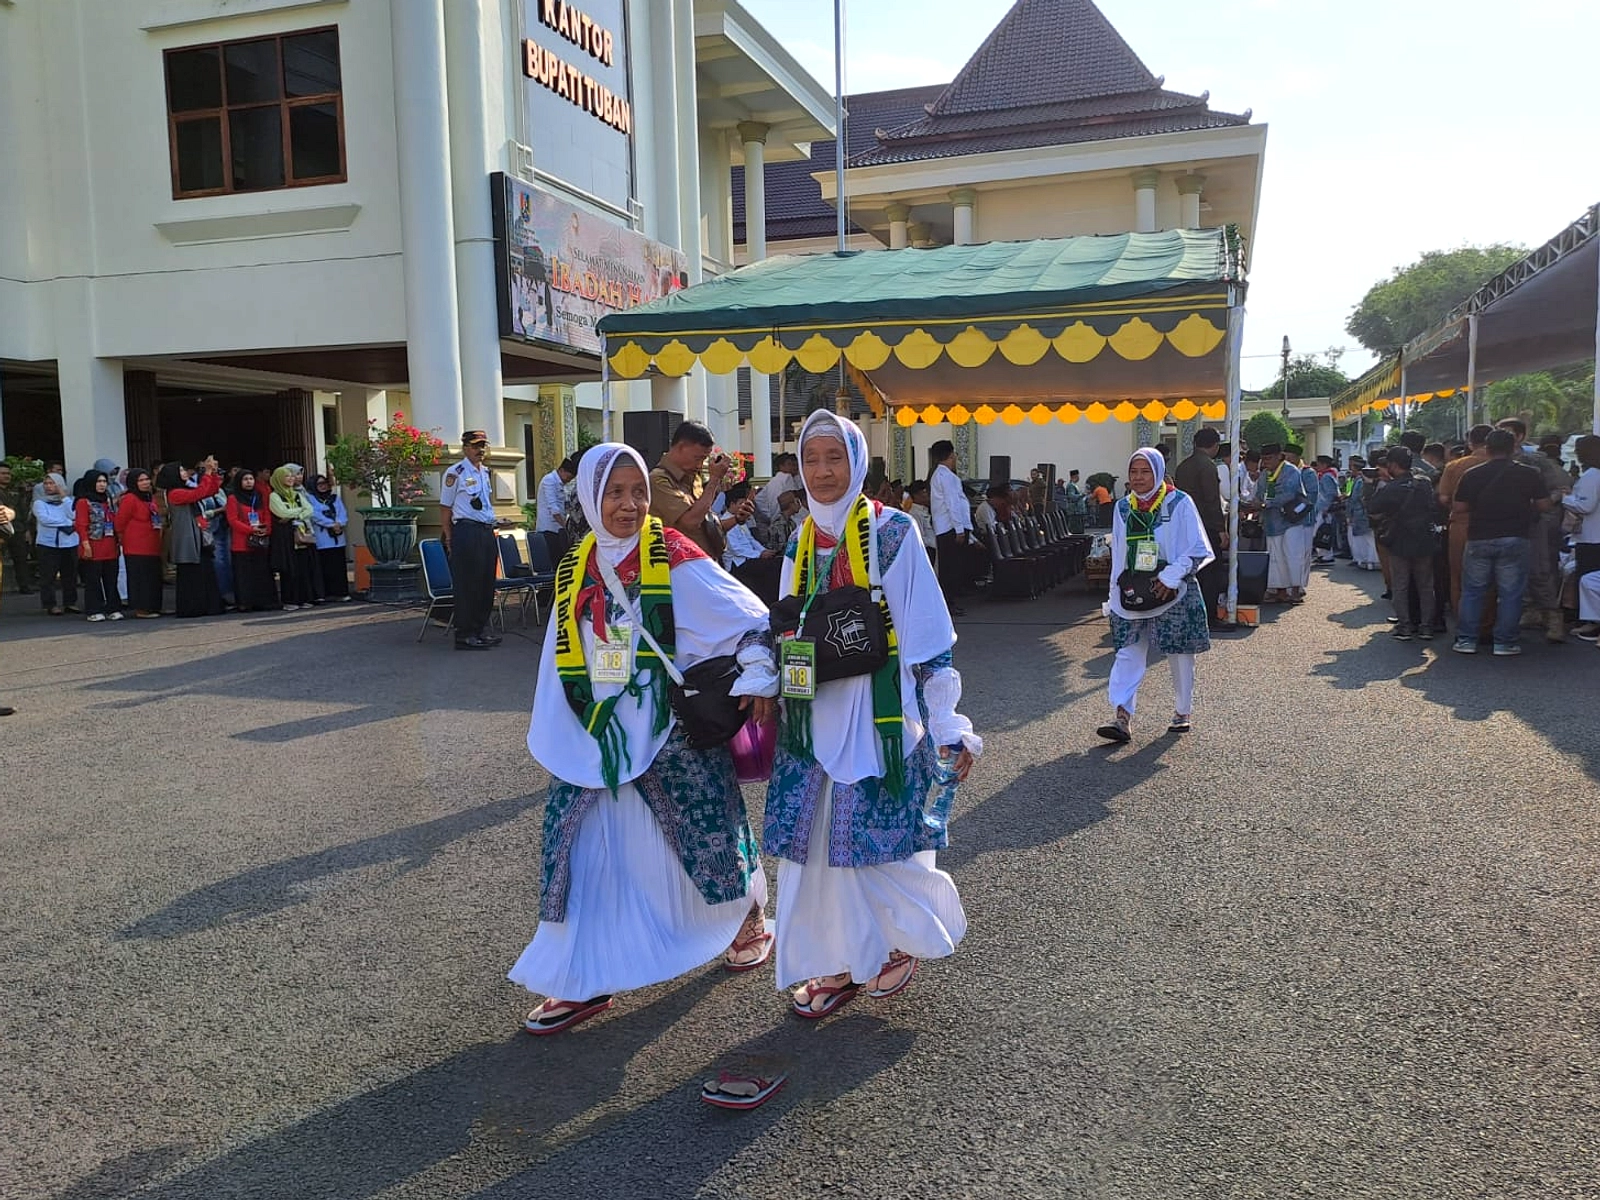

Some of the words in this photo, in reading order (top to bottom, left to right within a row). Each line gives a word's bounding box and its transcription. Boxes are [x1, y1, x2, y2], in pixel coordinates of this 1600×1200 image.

[542, 0, 613, 66] KANTOR
[524, 38, 583, 107] BUPATI
[583, 75, 630, 134] TUBAN
[552, 255, 623, 311] IBADAH
[556, 305, 588, 328] Semoga
[601, 651, 622, 670] 18
[788, 667, 807, 687] 18
